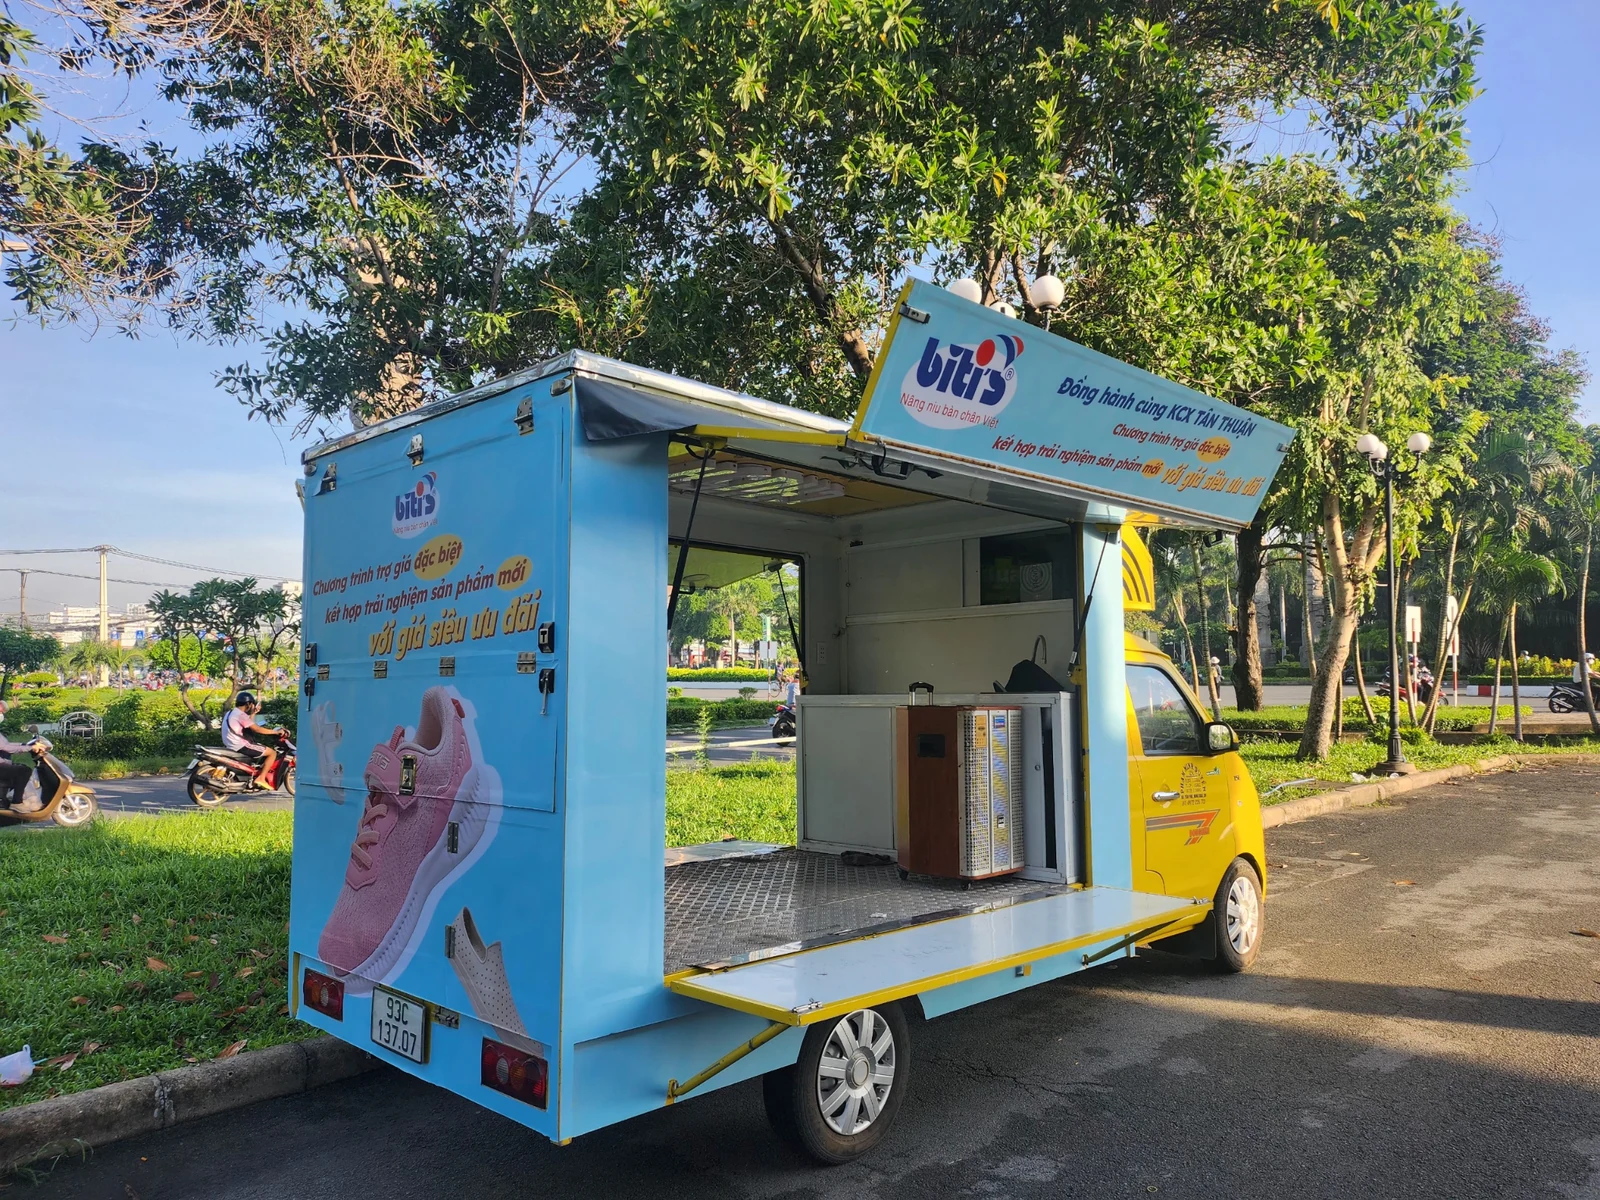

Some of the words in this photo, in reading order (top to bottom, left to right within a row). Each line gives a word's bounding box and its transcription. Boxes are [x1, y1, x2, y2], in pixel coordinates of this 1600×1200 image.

[900, 392, 926, 413] Nâng
[926, 401, 941, 414] niu
[942, 404, 959, 419] bàn
[960, 409, 981, 424] chân
[983, 414, 999, 430] Việt
[1057, 375, 1100, 406] Đồng
[1098, 386, 1135, 410] hành
[1135, 396, 1168, 421] cùng
[1166, 404, 1196, 423] KCX
[1193, 407, 1220, 429] TÂN
[1218, 416, 1258, 439] THUẬN
[992, 433, 1015, 451] kết
[1012, 439, 1036, 458] hợp
[1036, 443, 1061, 459] trải
[1057, 448, 1097, 466] nghiệm
[1096, 453, 1116, 468] sản
[1112, 455, 1142, 472] phẩm
[1141, 462, 1164, 475] mới
[1160, 462, 1189, 485] với
[1177, 466, 1208, 492] giá
[1201, 468, 1230, 492] siêu
[1225, 476, 1245, 494] ưu
[1241, 476, 1267, 496] đãi
[1112, 423, 1149, 443] Chương
[1148, 431, 1171, 445] trình
[1170, 435, 1186, 450] trợ
[1182, 437, 1200, 452] giá
[1198, 440, 1215, 455] đặc
[1213, 443, 1231, 459] biệt
[312, 576, 347, 596] Chương
[350, 565, 374, 587] trình
[376, 562, 393, 582] trợ
[393, 553, 412, 580] giá
[414, 548, 436, 572] đặc
[438, 541, 463, 565] biệt
[325, 601, 341, 624] kết
[342, 603, 361, 623] hợp
[364, 593, 385, 616] trải
[386, 586, 428, 614] nghiệm
[430, 578, 453, 600] sản
[455, 565, 494, 600] phẩm
[497, 558, 528, 586] mới
[369, 619, 397, 657] với
[395, 613, 426, 661] giá
[428, 607, 468, 647] siêu
[471, 606, 499, 640] ưu
[502, 589, 542, 635] đãi
[378, 1019, 417, 1056] 137.07
[386, 996, 409, 1025] 93C
